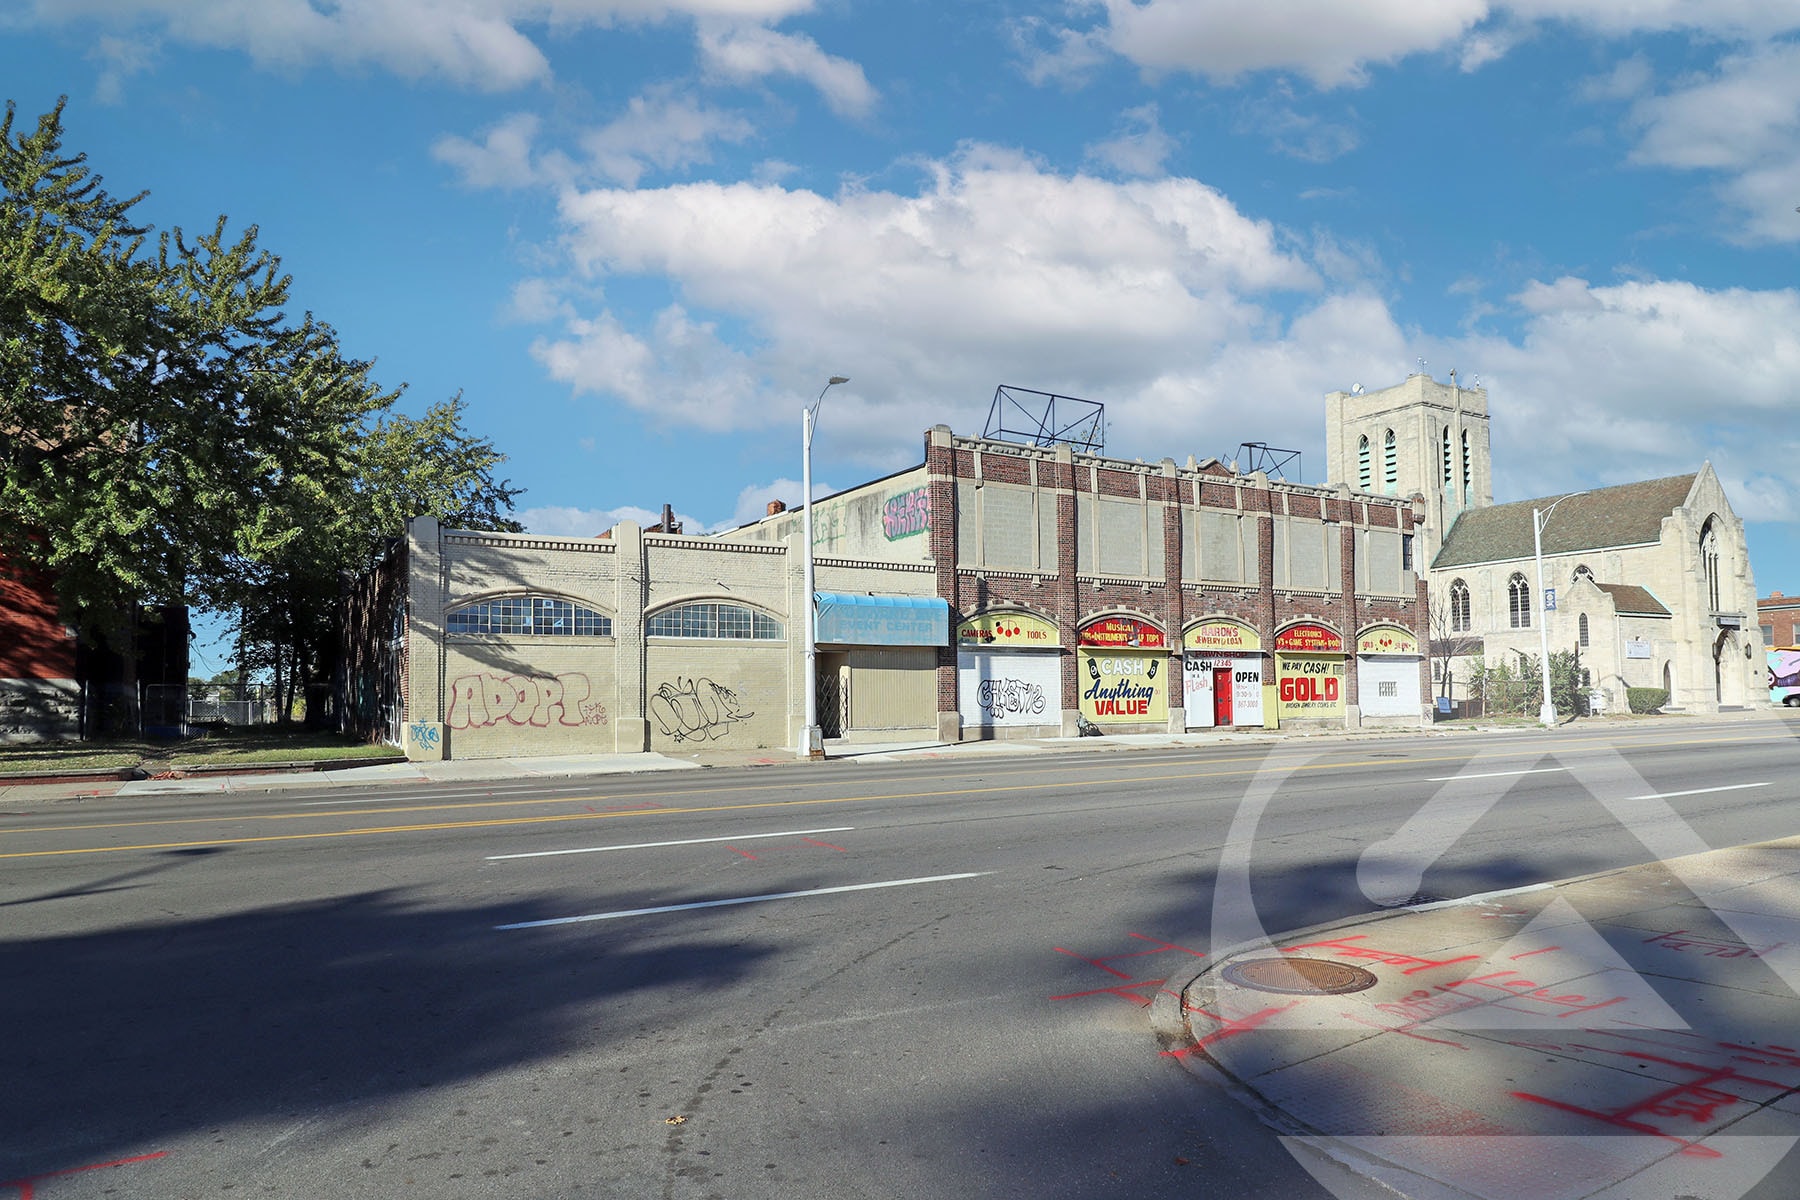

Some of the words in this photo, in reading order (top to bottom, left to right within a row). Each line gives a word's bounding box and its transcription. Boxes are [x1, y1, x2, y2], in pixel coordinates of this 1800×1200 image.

[886, 621, 933, 632] CENTER
[961, 629, 992, 638] CAMERAS
[1026, 631, 1047, 640] TOOLS
[1101, 657, 1144, 676] CASH
[1185, 661, 1212, 672] CASH
[1282, 662, 1291, 671] WE
[1291, 662, 1303, 671] PAY
[1303, 662, 1330, 674] CASH!
[1235, 672, 1260, 683] OPEN
[1084, 678, 1154, 707] Anything
[1280, 677, 1339, 702] GOLD
[1095, 699, 1148, 715] VALUE
